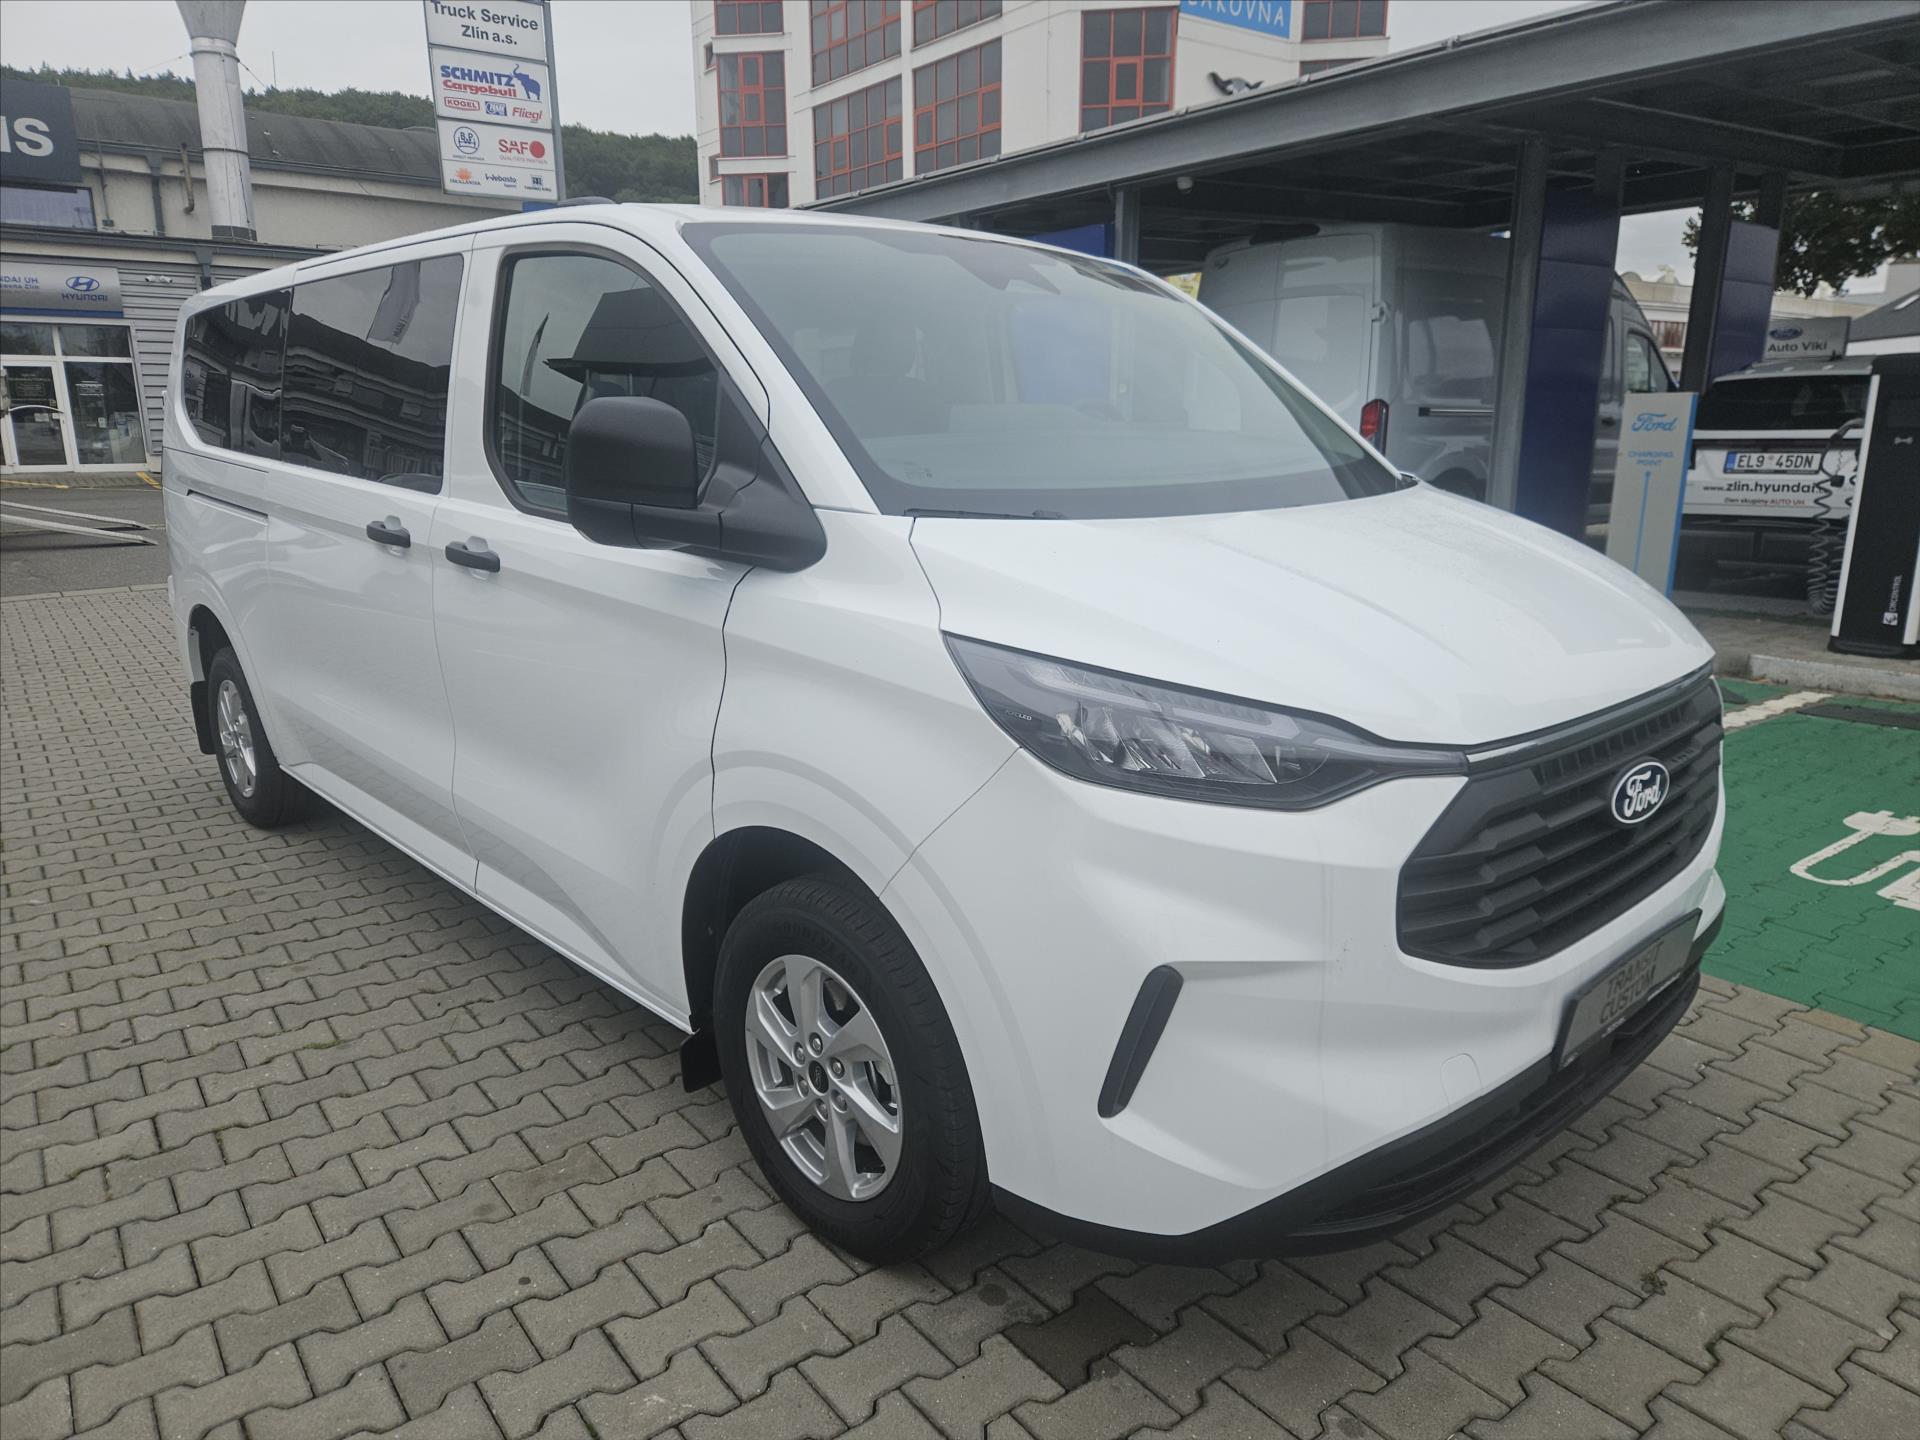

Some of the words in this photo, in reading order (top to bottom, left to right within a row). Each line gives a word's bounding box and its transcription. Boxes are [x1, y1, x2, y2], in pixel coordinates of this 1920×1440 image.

[431, 1, 477, 20] Truck
[481, 8, 539, 30] Service
[492, 32, 518, 45] a.s.
[440, 65, 516, 88] SCHMITZ
[443, 79, 517, 97] Cargobull
[498, 138, 529, 154] SAF
[61, 293, 108, 301] HYUNDAI
[1768, 343, 1798, 352] Auto
[1631, 412, 1679, 432] Ford
[1736, 455, 1766, 468] EL9
[1775, 455, 1814, 469] 45DN
[1623, 771, 1662, 818] Ford
[1607, 939, 1665, 999] TRANSIT
[1600, 964, 1657, 1025] CUSTOM
